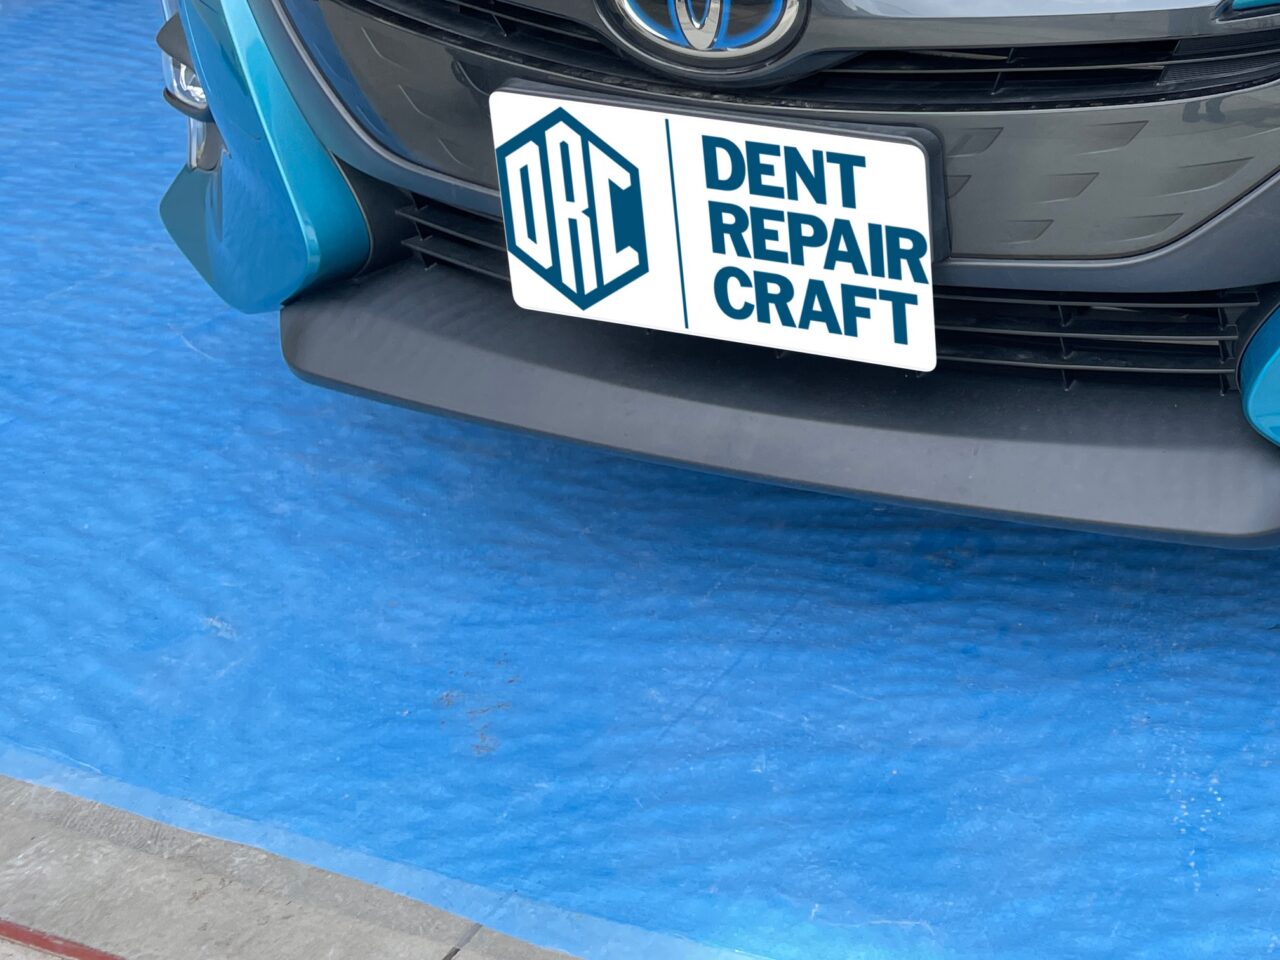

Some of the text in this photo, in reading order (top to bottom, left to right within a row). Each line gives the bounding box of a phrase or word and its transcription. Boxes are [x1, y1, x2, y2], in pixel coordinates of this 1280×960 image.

[702, 135, 866, 209] DENT
[708, 200, 929, 284] REPAIR
[713, 266, 918, 345] CRAFT
